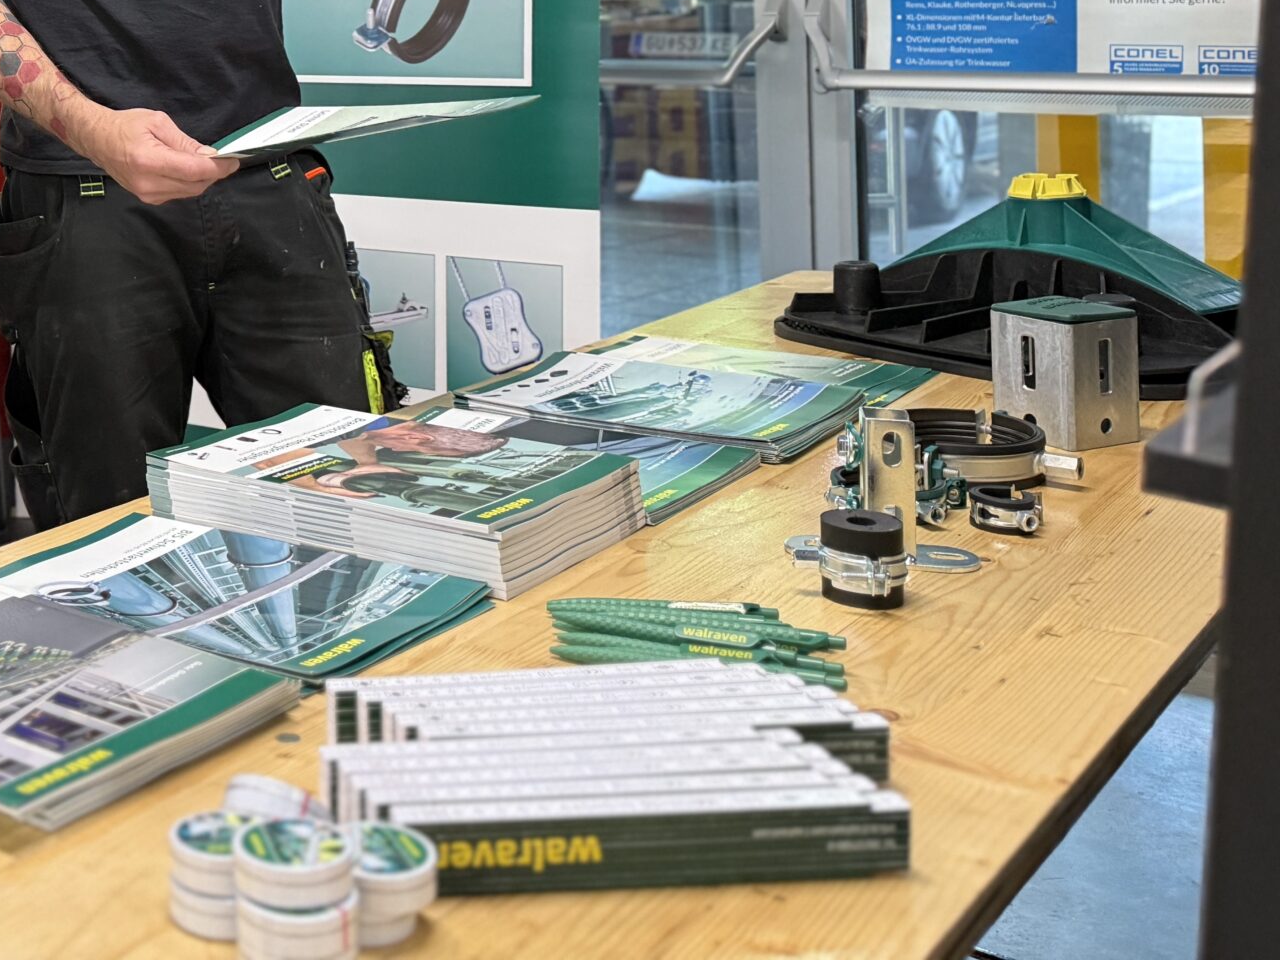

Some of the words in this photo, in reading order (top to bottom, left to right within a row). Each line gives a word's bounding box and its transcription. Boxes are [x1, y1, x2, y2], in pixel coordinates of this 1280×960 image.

[1114, 48, 1179, 59] CONEL
[1112, 62, 1123, 75] 5
[1201, 64, 1219, 76] 10
[683, 627, 747, 644] walraven
[299, 638, 366, 667] walraven
[688, 644, 753, 660] walraven
